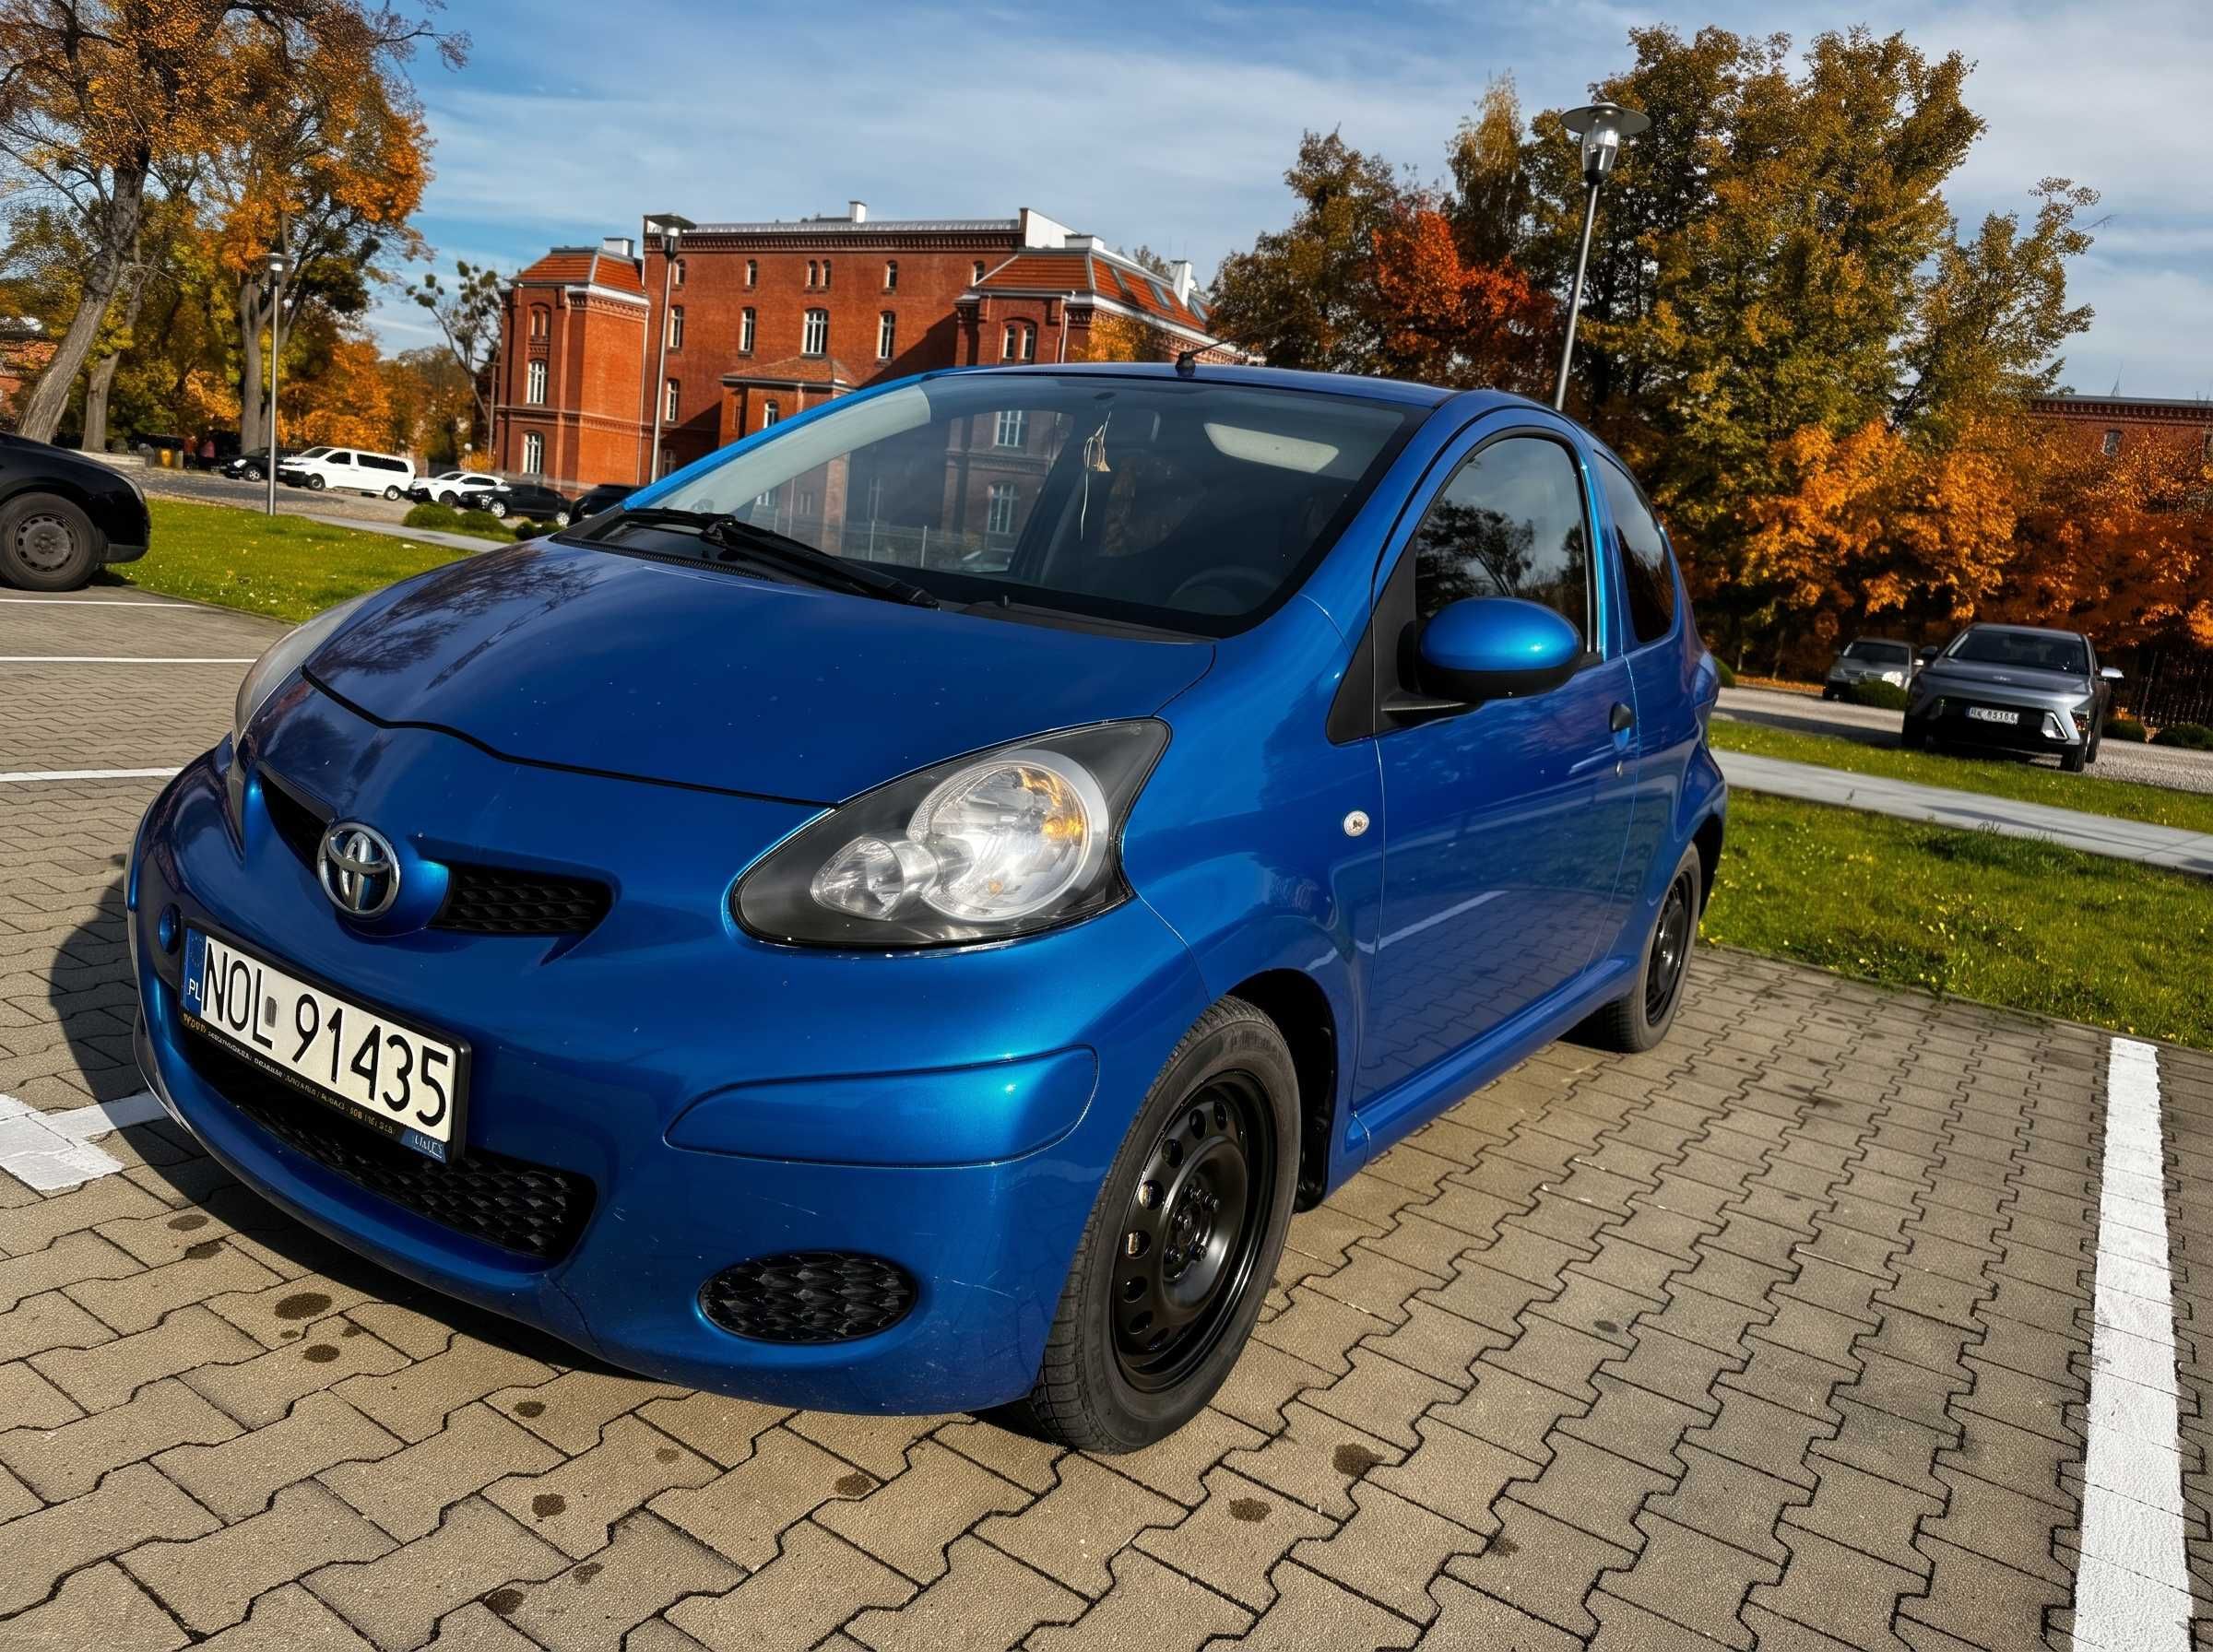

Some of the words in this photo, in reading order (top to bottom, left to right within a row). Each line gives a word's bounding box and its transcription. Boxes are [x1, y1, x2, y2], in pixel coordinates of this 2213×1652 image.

[188, 978, 201, 1001] PL
[203, 943, 273, 1050] NOL
[291, 994, 448, 1127] 91435
